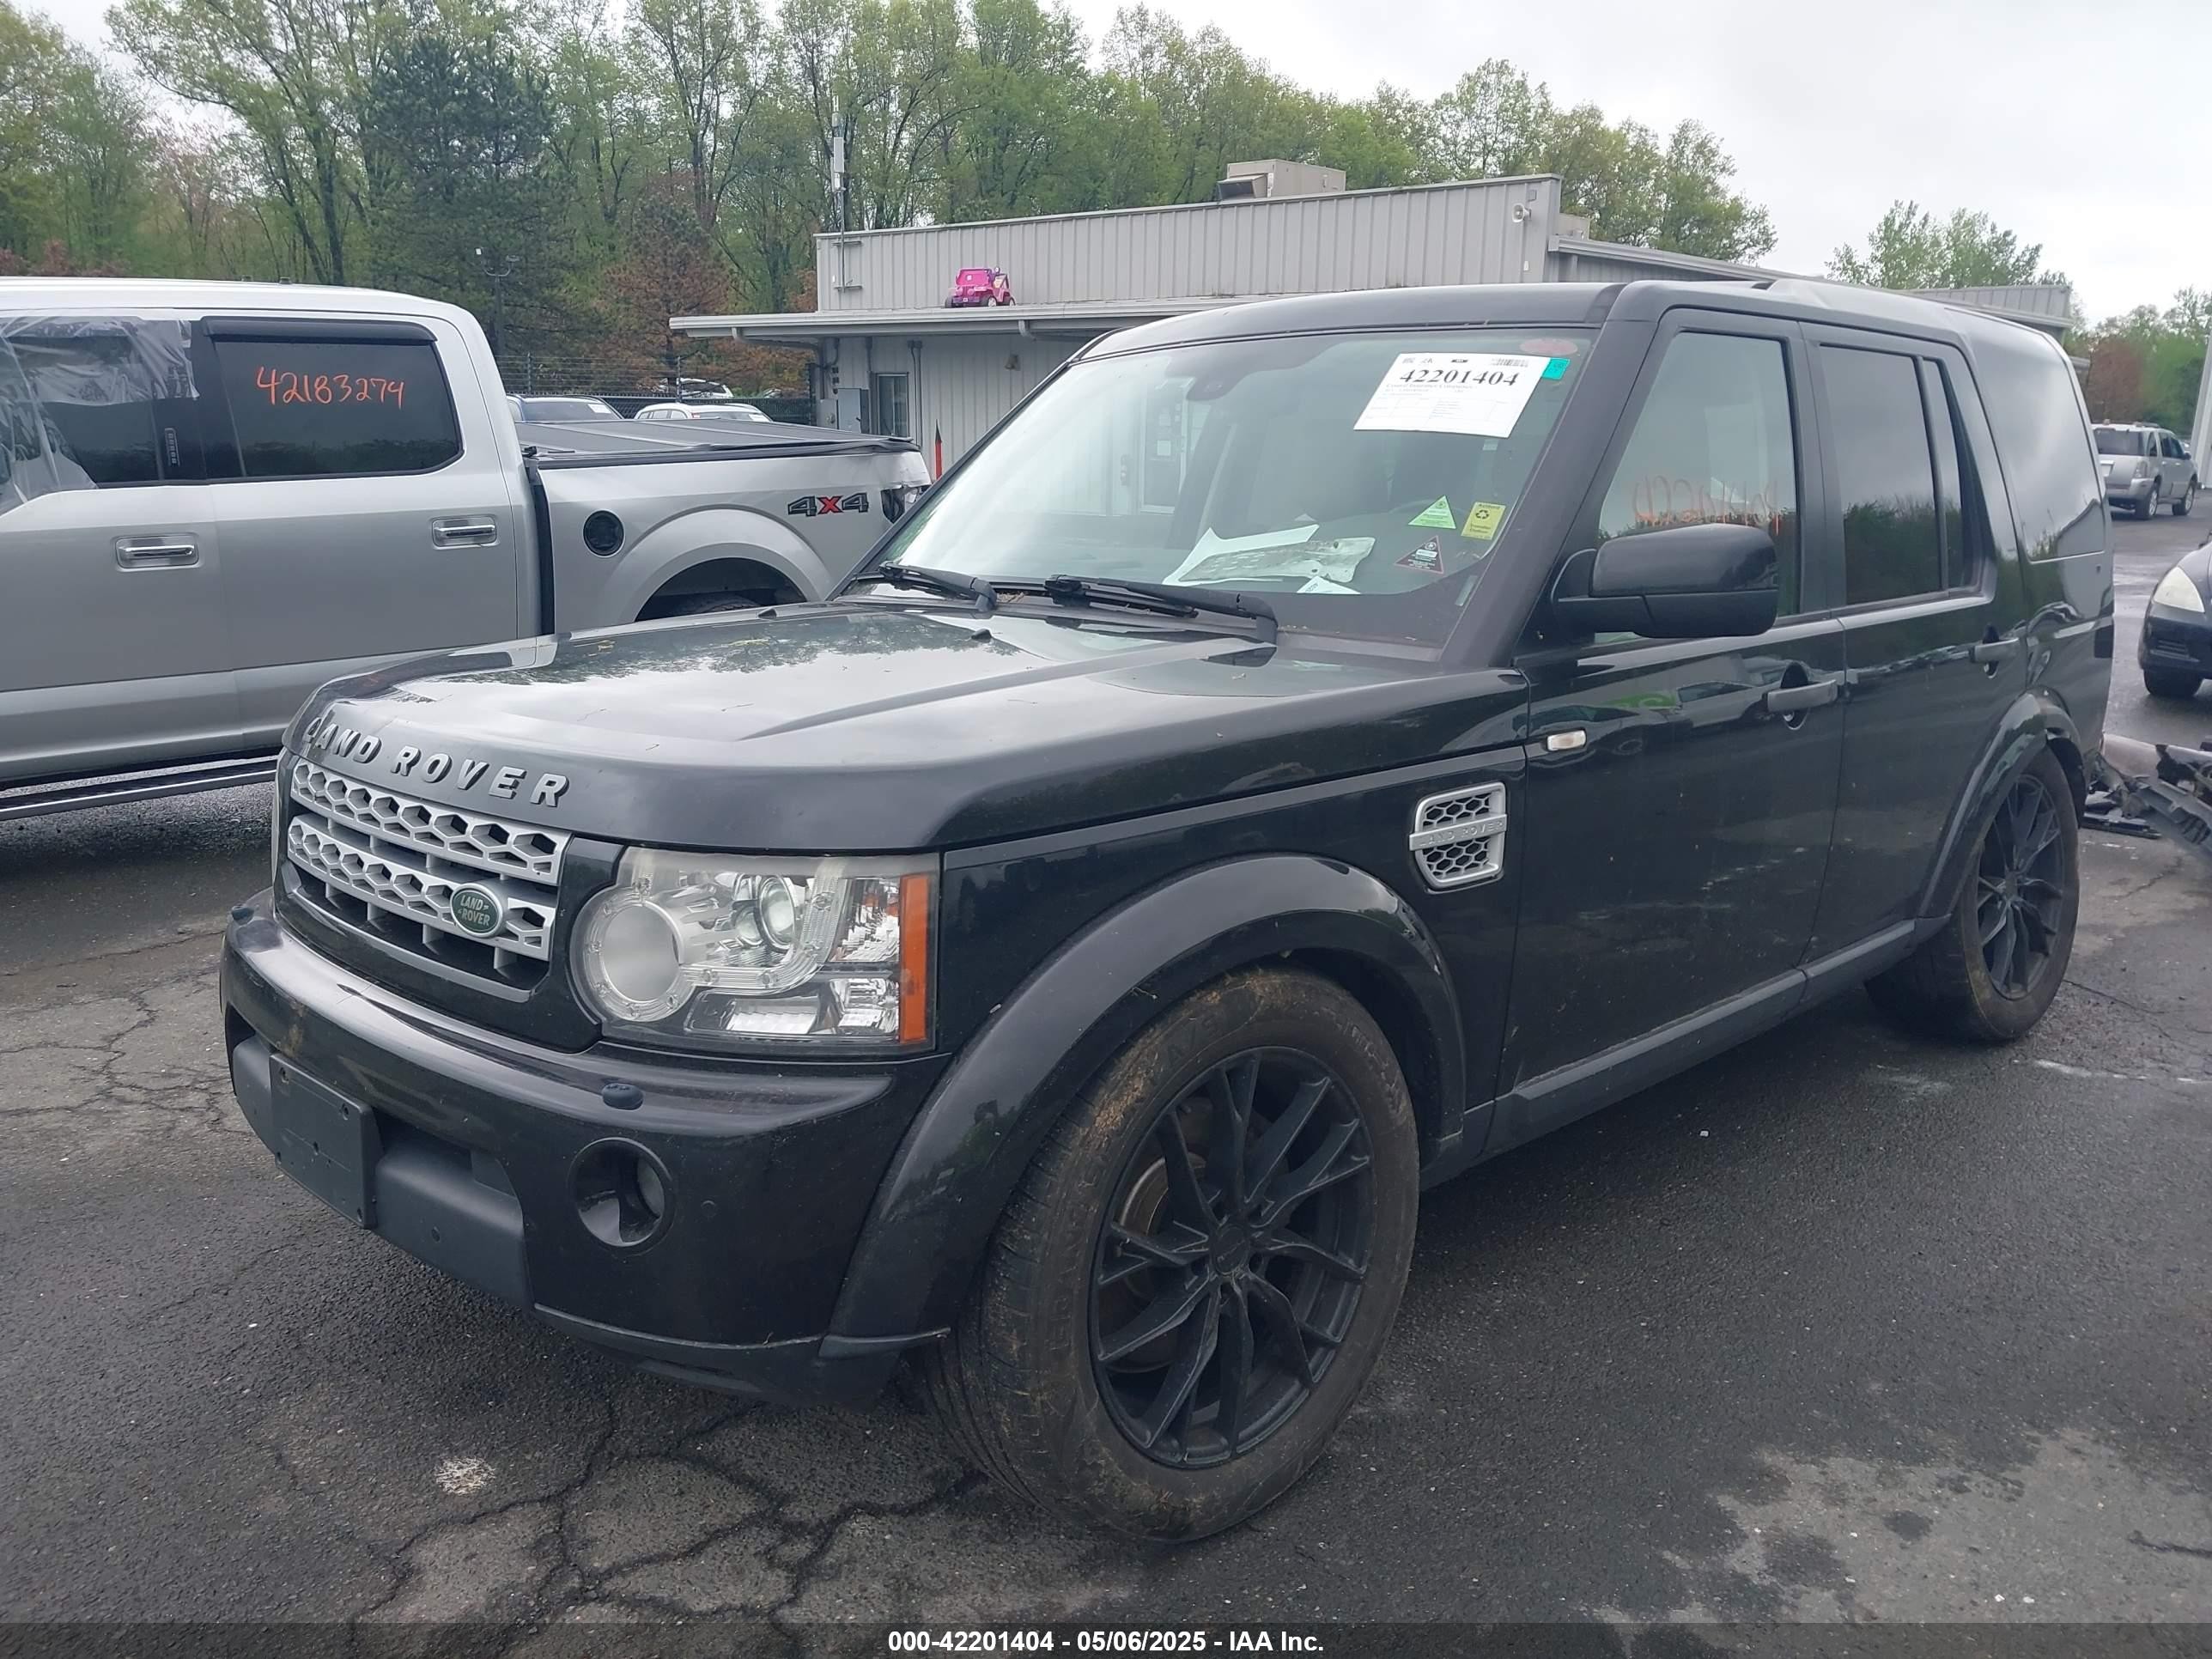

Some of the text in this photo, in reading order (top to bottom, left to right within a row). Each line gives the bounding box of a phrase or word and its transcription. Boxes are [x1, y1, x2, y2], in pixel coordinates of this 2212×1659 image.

[1399, 368, 1519, 386] 42201404
[303, 718, 570, 807] LAND ROVER
[1462, 820, 1503, 838] ROVER
[460, 895, 483, 910] LAND
[462, 908, 491, 927] ROVER
